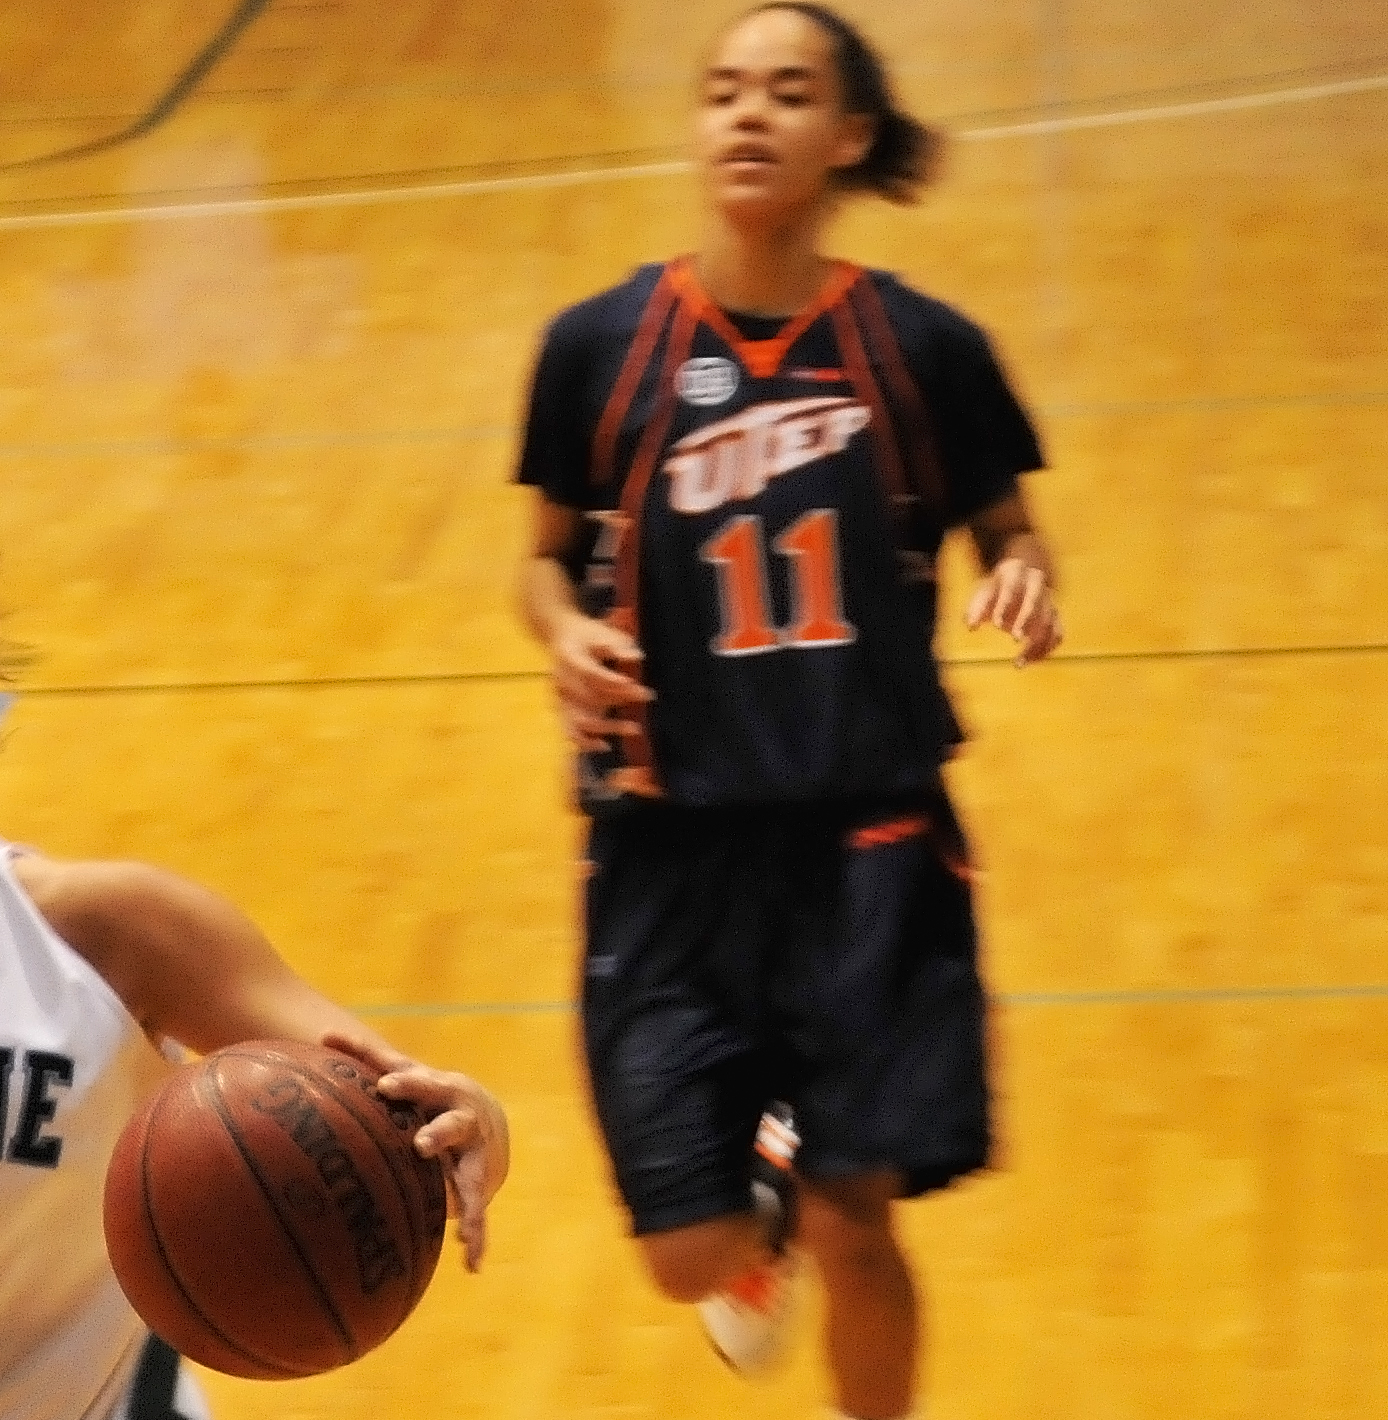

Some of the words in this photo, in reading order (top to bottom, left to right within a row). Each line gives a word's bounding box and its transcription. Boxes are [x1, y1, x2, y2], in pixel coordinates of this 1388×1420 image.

[664, 398, 872, 514] UTEP
[699, 508, 858, 657] 11
[252, 1076, 406, 1294] SPALDING
